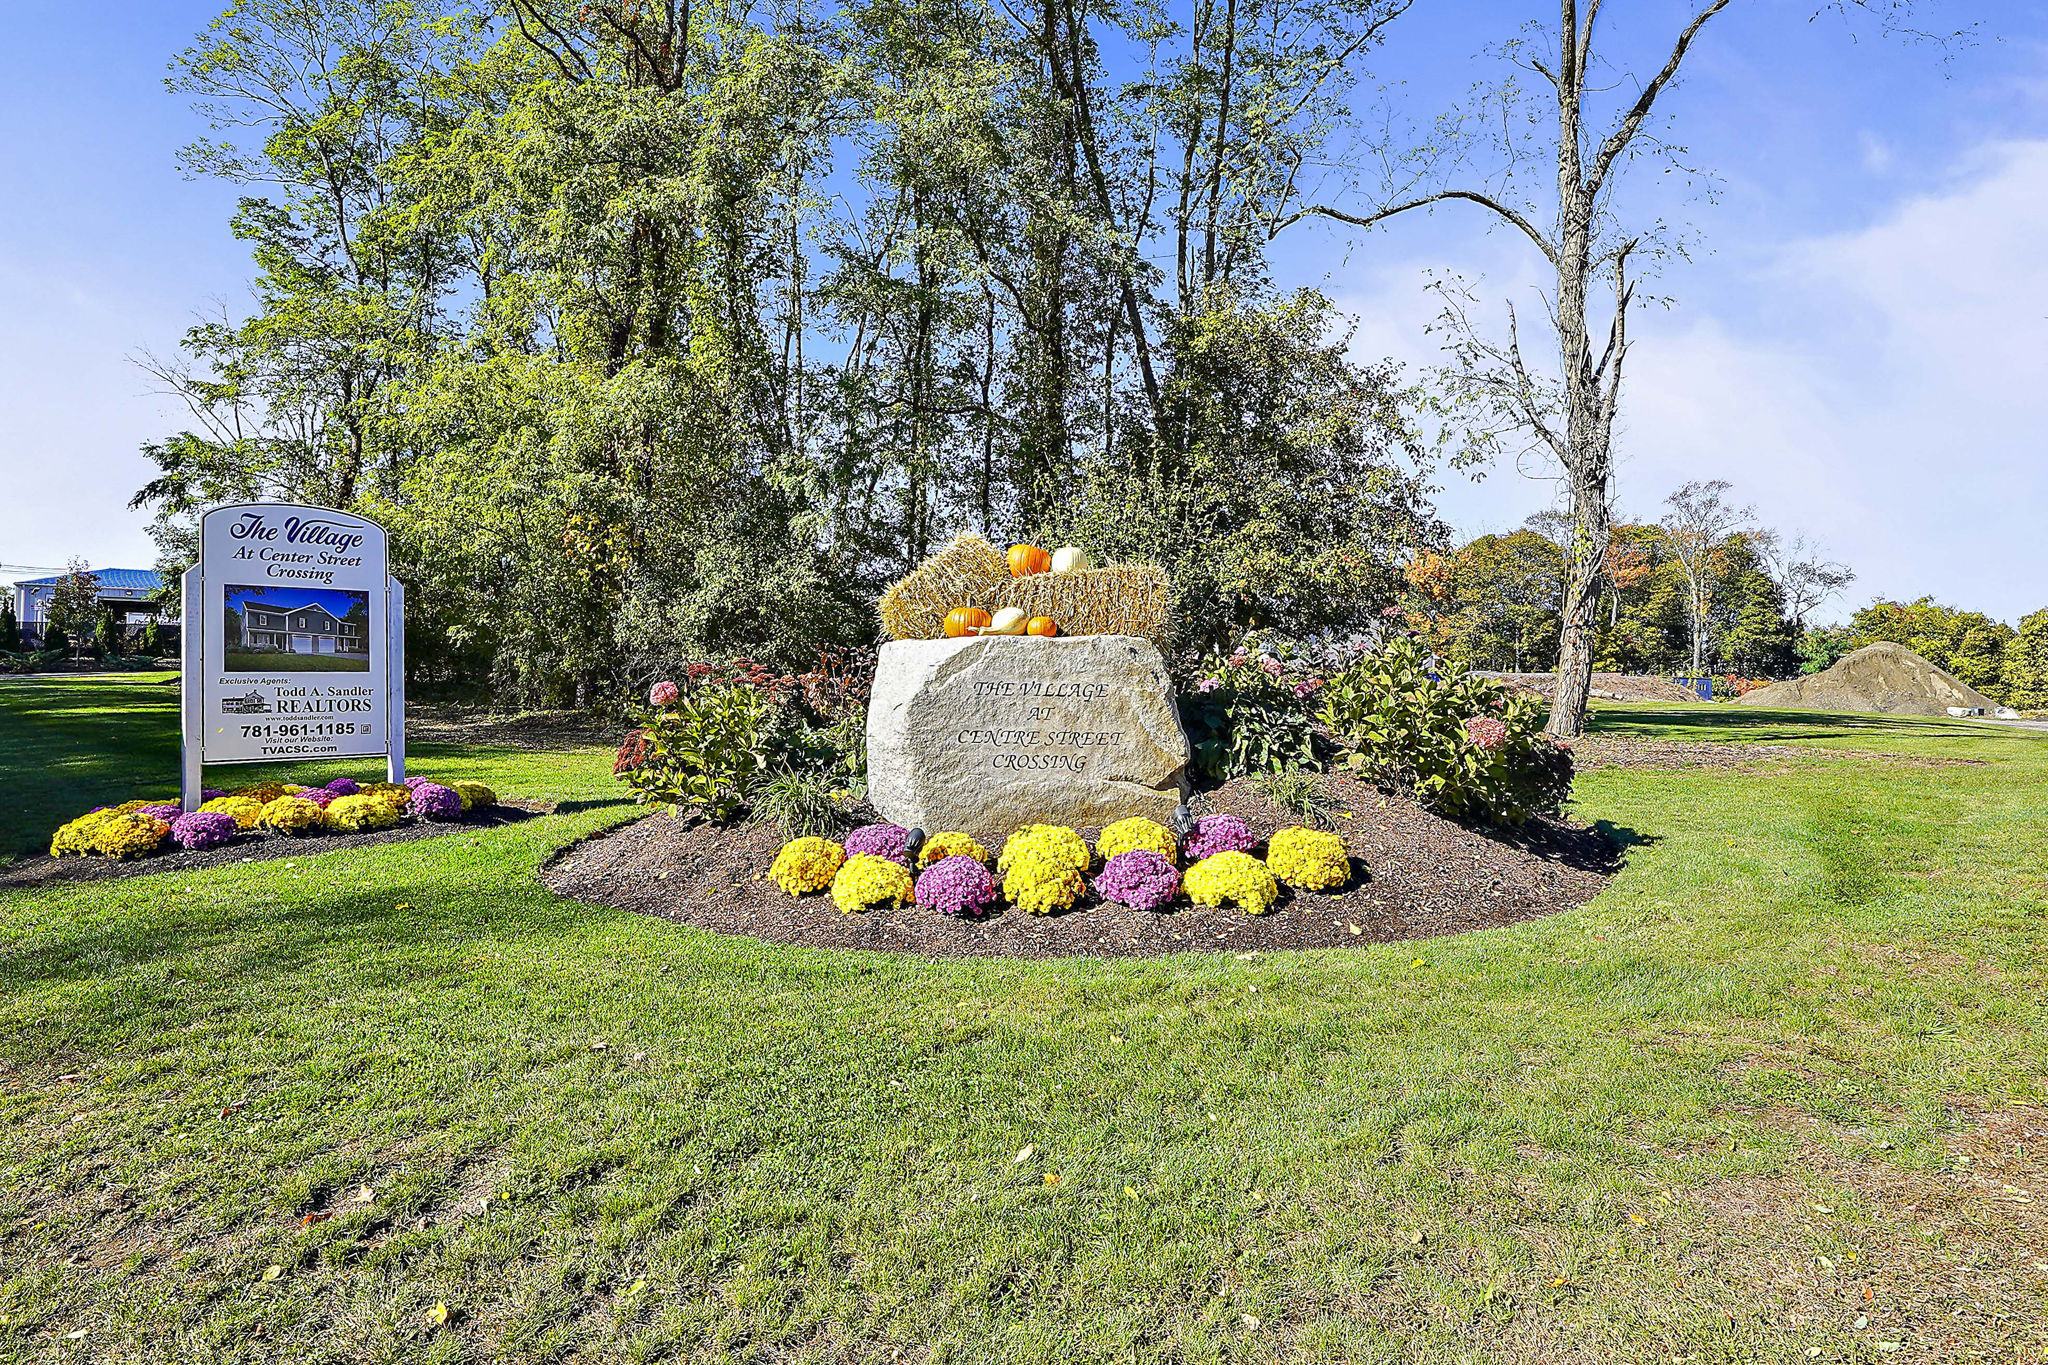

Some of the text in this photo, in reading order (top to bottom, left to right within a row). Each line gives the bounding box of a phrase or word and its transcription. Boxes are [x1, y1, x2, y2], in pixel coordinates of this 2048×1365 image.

[230, 513, 364, 553] The Village
[232, 546, 361, 566] At Center Street
[266, 564, 334, 584] Crossing
[260, 678, 291, 686] Agents:
[274, 686, 374, 697] Todd A. Sandler
[973, 681, 1109, 702] THE VILLAGE
[276, 699, 372, 713] REALTORS
[1027, 707, 1055, 721] AT
[241, 723, 355, 737] 781-961-1185
[958, 729, 1126, 748] CENTRE STREET
[261, 745, 337, 754] TVACSC.com
[993, 753, 1087, 773] CROSSING
